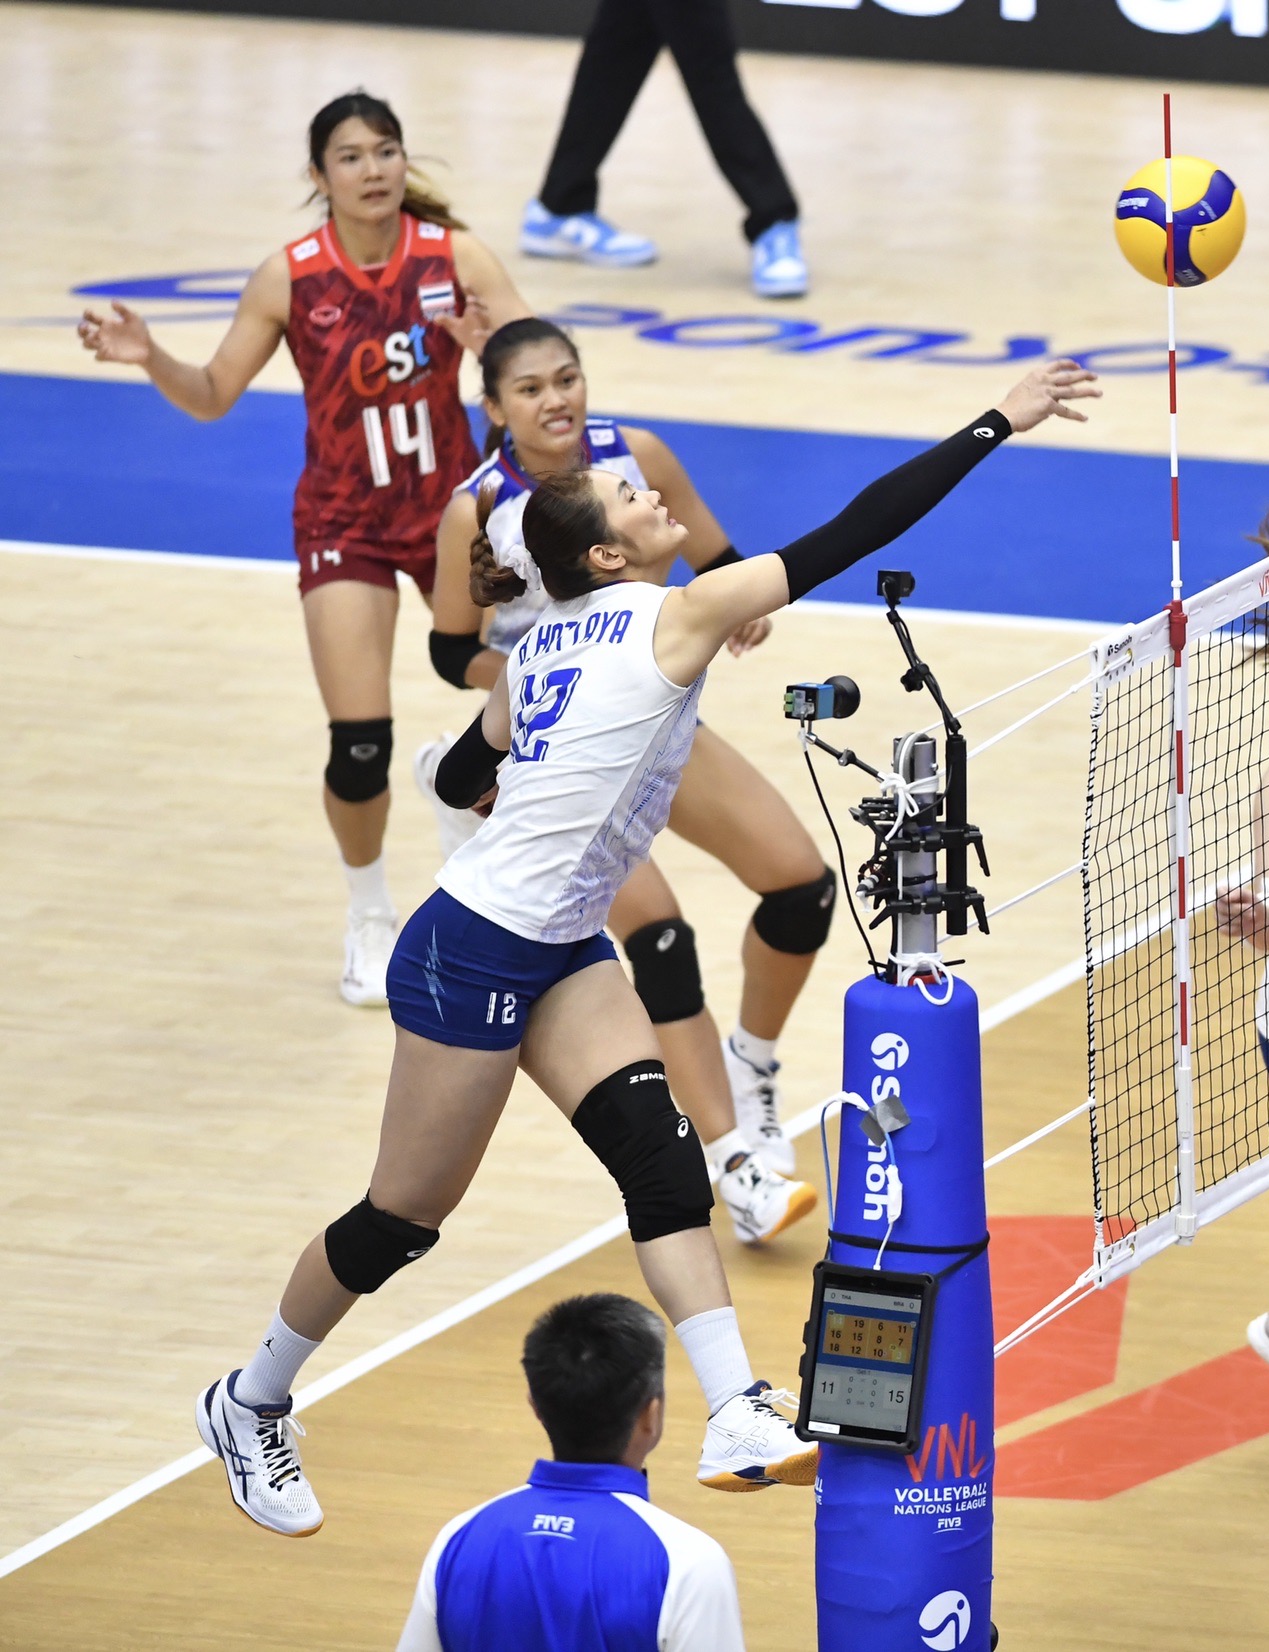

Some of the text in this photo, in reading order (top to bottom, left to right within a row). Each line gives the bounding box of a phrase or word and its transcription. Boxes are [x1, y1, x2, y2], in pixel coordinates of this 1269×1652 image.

[350, 323, 430, 396] est
[362, 398, 437, 488] 14
[511, 667, 582, 764] 12
[486, 992, 517, 1024] 12
[854, 1319, 865, 1328] 19
[878, 1322, 884, 1331] 6
[898, 1325, 907, 1334] 11
[831, 1330, 904, 1346] 16 15 8 7
[830, 1343, 840, 1352] 18
[851, 1346, 862, 1355] 12
[873, 1349, 883, 1357] 10
[821, 1381, 834, 1394] 11
[888, 1390, 904, 1404] 15
[904, 1413, 986, 1483] VNL
[894, 1482, 987, 1503] VOLLEYBALL
[894, 1498, 986, 1515] NATIONS LEAGUE
